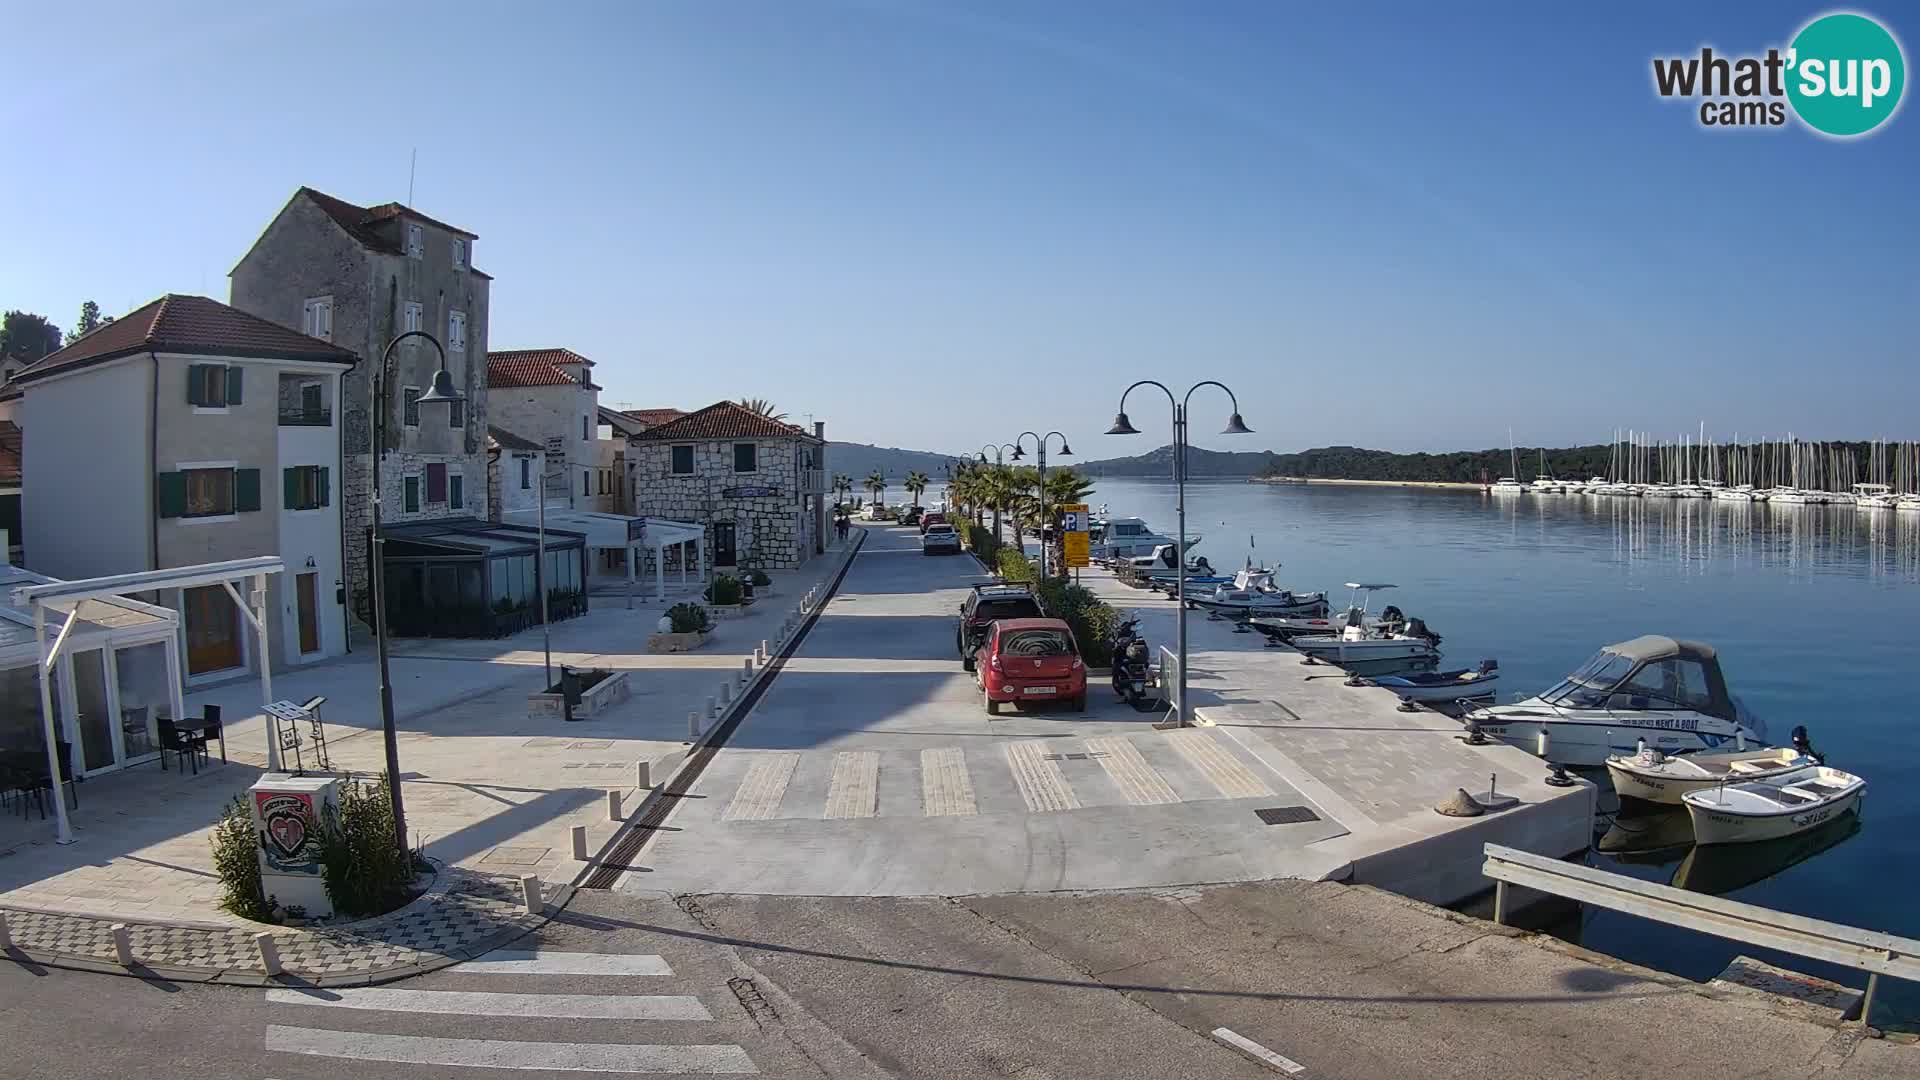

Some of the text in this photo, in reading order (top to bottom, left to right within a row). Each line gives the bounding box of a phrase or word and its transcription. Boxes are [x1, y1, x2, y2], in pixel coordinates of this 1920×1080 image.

[1066, 514, 1076, 529] P
[1655, 719, 1674, 729] RENT
[1675, 719, 1680, 729] A
[1681, 719, 1699, 730] BOAT
